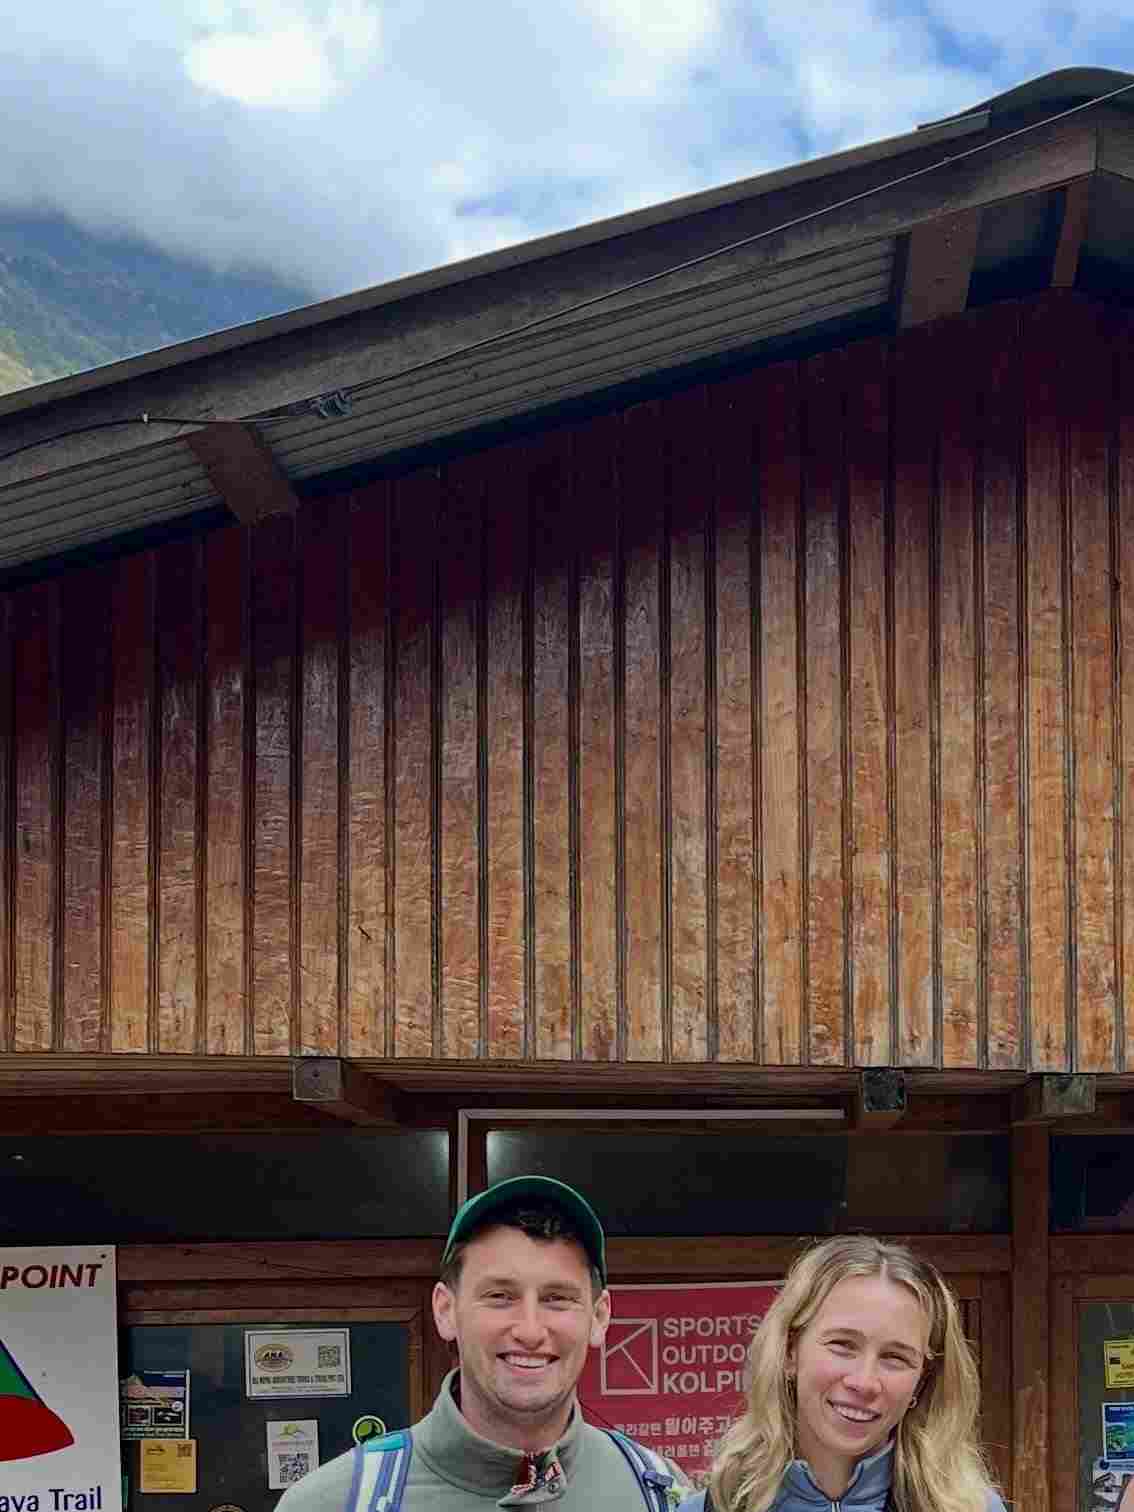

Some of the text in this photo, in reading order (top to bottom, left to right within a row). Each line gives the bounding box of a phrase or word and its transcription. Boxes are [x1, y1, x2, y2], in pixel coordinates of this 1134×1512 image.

[1, 1263, 103, 1289] POINT
[662, 1314, 761, 1339] SPORTS
[662, 1370, 750, 1395] KOLPI
[49, 1485, 102, 1511] Trail
